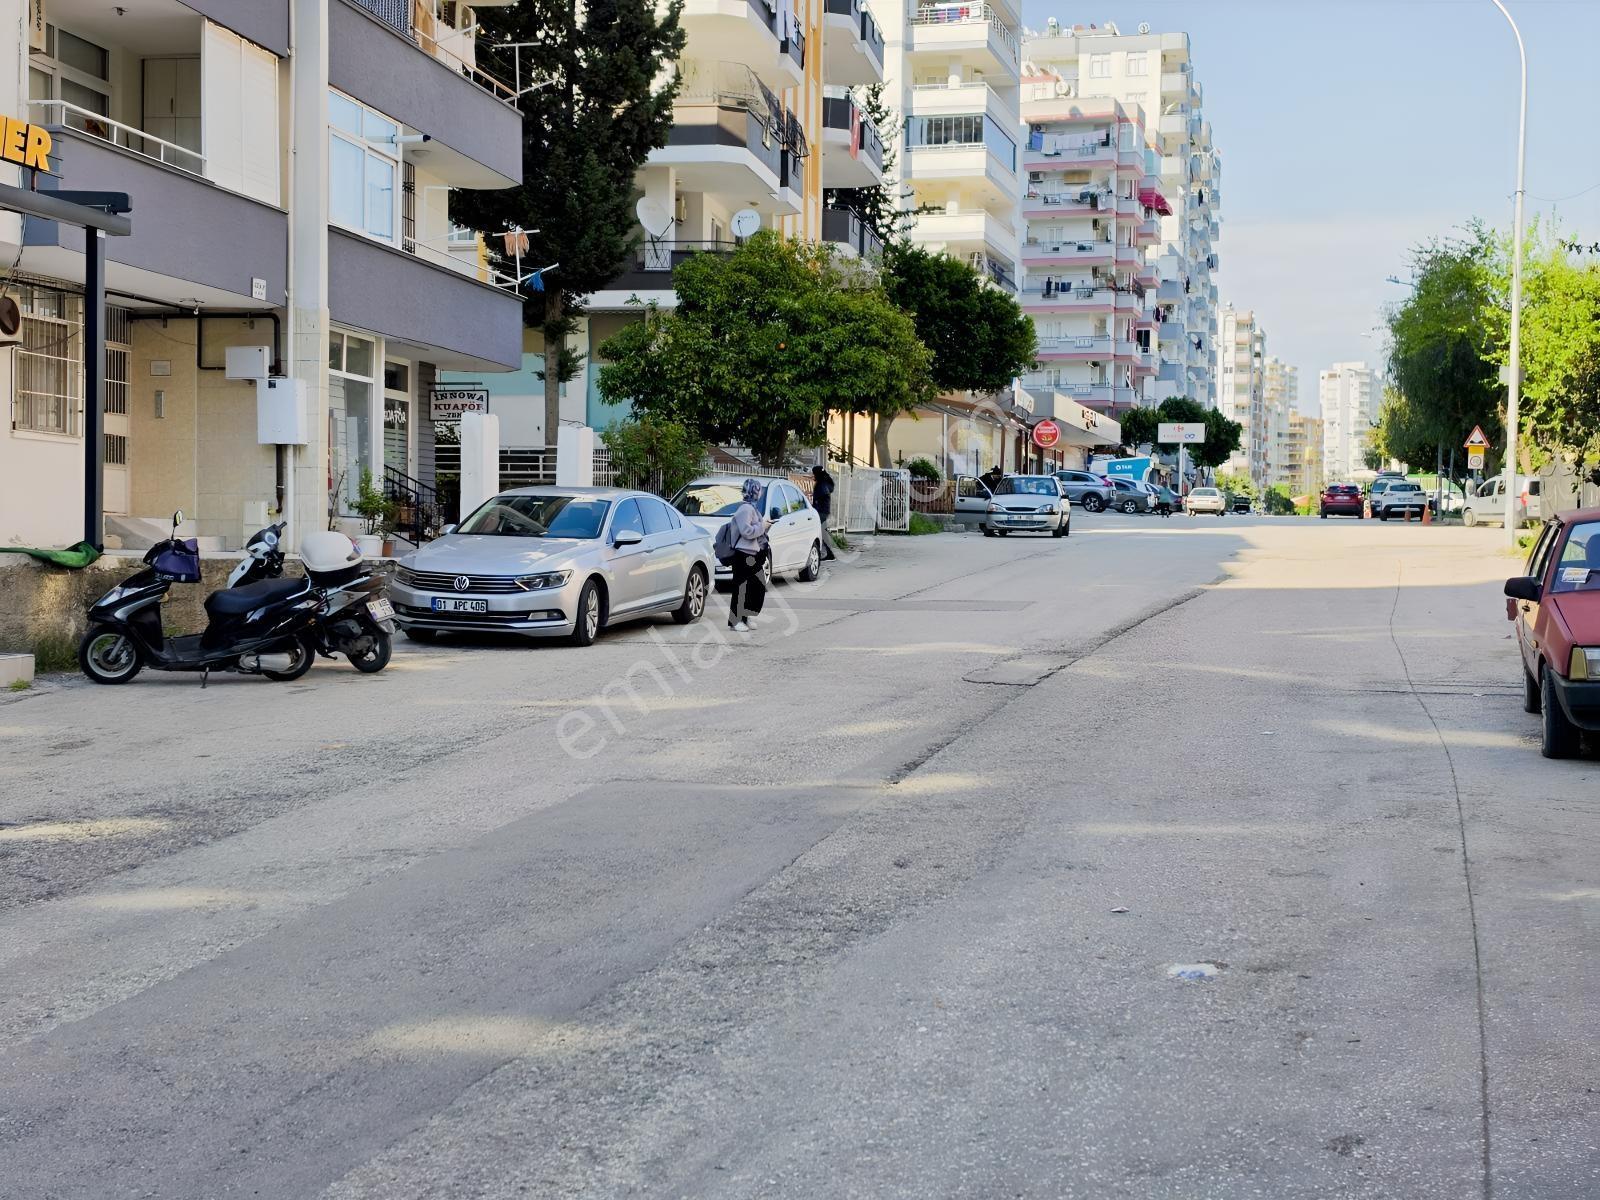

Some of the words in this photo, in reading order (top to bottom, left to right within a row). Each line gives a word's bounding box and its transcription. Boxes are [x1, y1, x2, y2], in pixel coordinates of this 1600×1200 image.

[0, 115, 52, 171] ER
[437, 600, 446, 609] 01
[453, 601, 468, 610] APC
